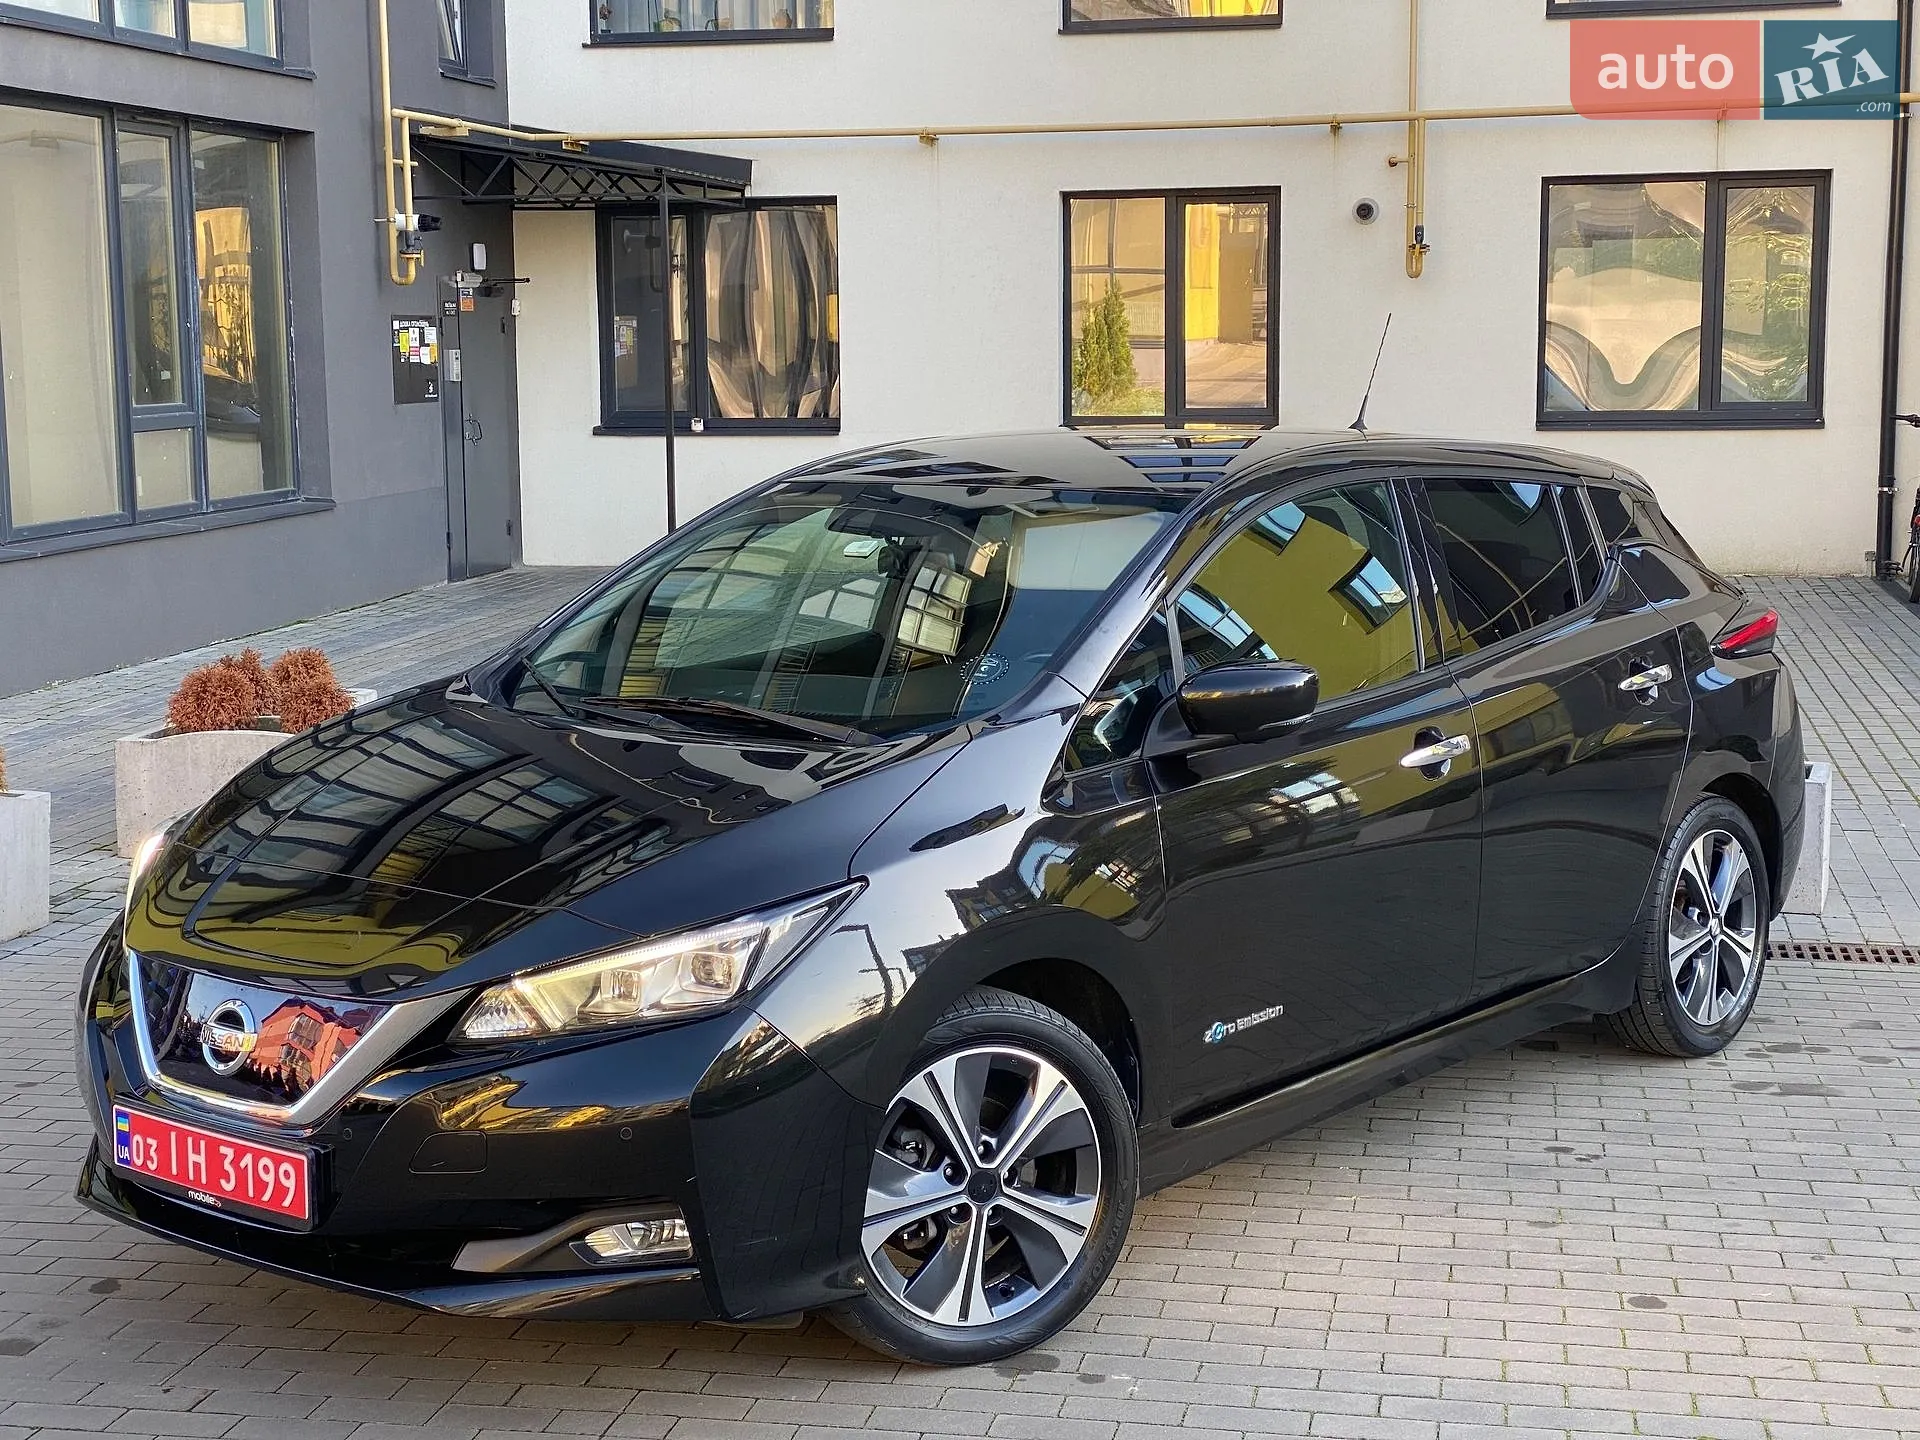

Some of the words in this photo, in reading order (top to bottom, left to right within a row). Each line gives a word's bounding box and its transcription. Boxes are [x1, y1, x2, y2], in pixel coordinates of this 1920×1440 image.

[201, 1025, 245, 1048] NISSAN
[118, 1144, 130, 1161] UA
[132, 1134, 158, 1171] 03
[219, 1145, 296, 1208] 3199
